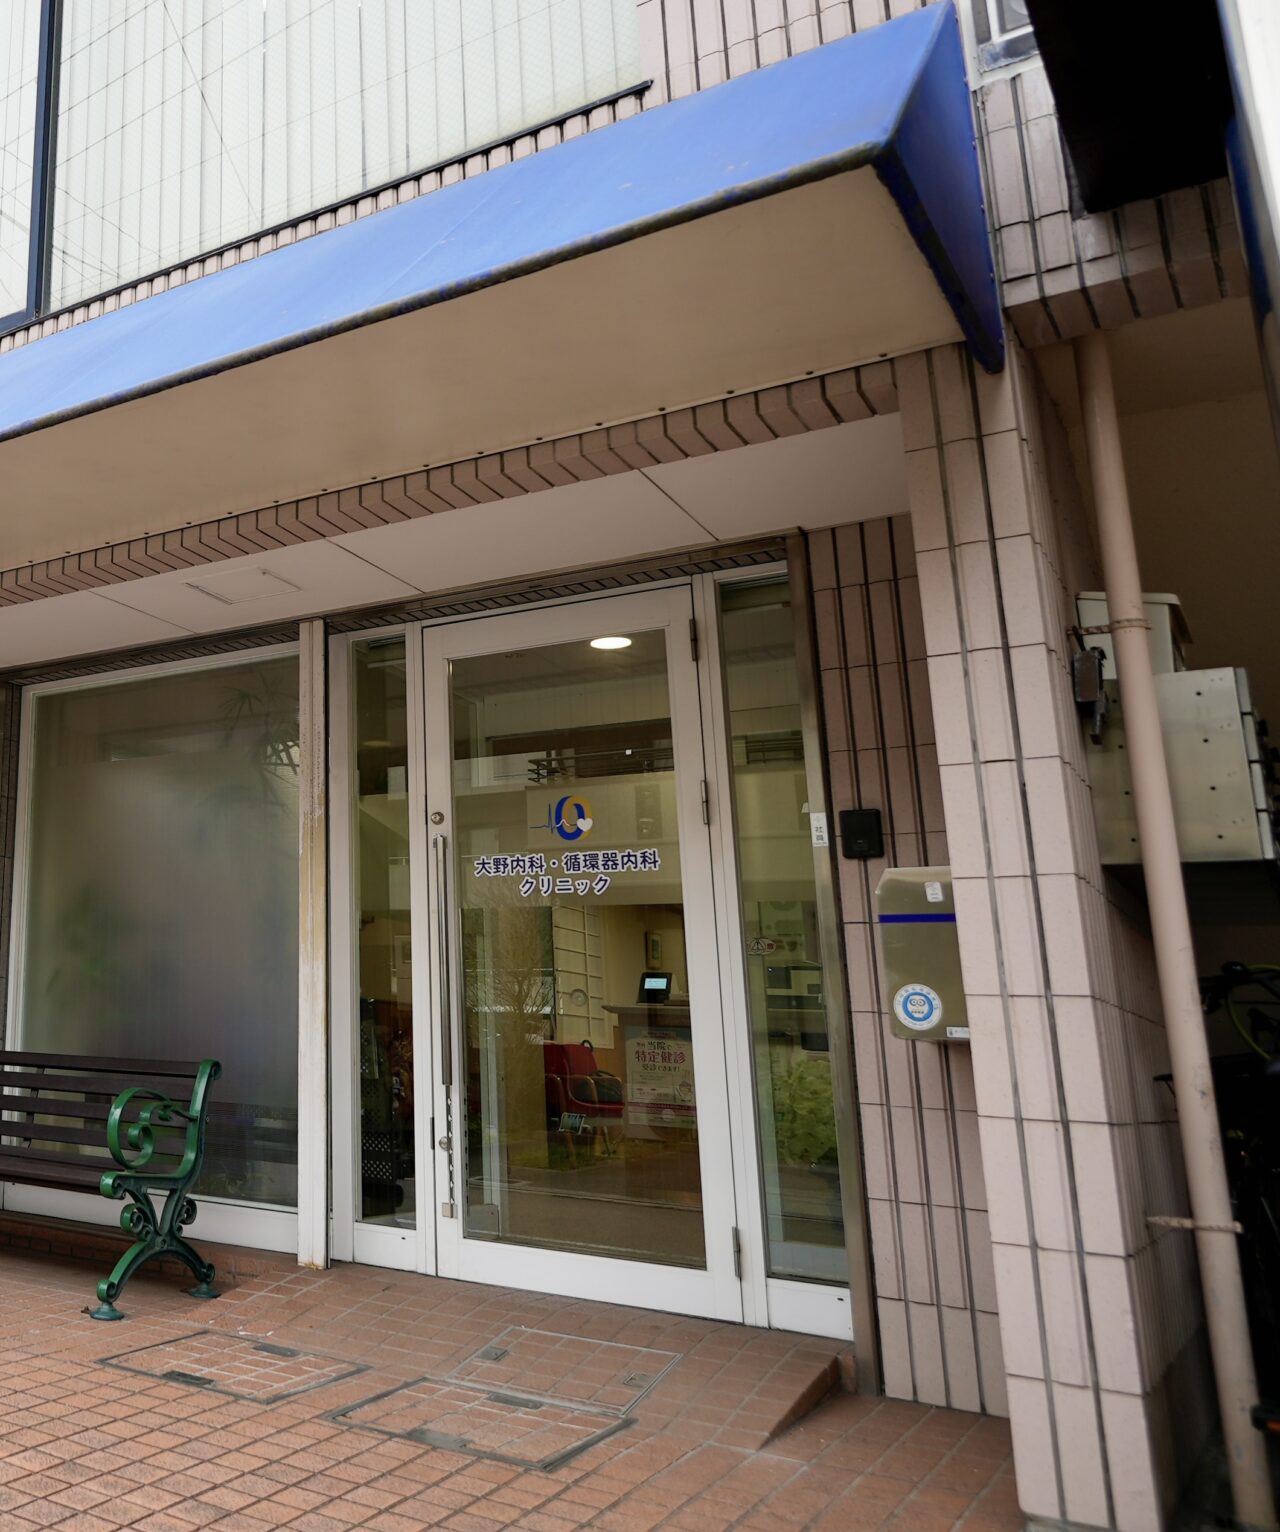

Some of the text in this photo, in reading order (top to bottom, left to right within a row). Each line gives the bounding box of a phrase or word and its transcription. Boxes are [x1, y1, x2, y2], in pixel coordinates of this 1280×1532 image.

[474, 849, 661, 876] 大野内科・循環器内科
[519, 874, 611, 897] クリニック
